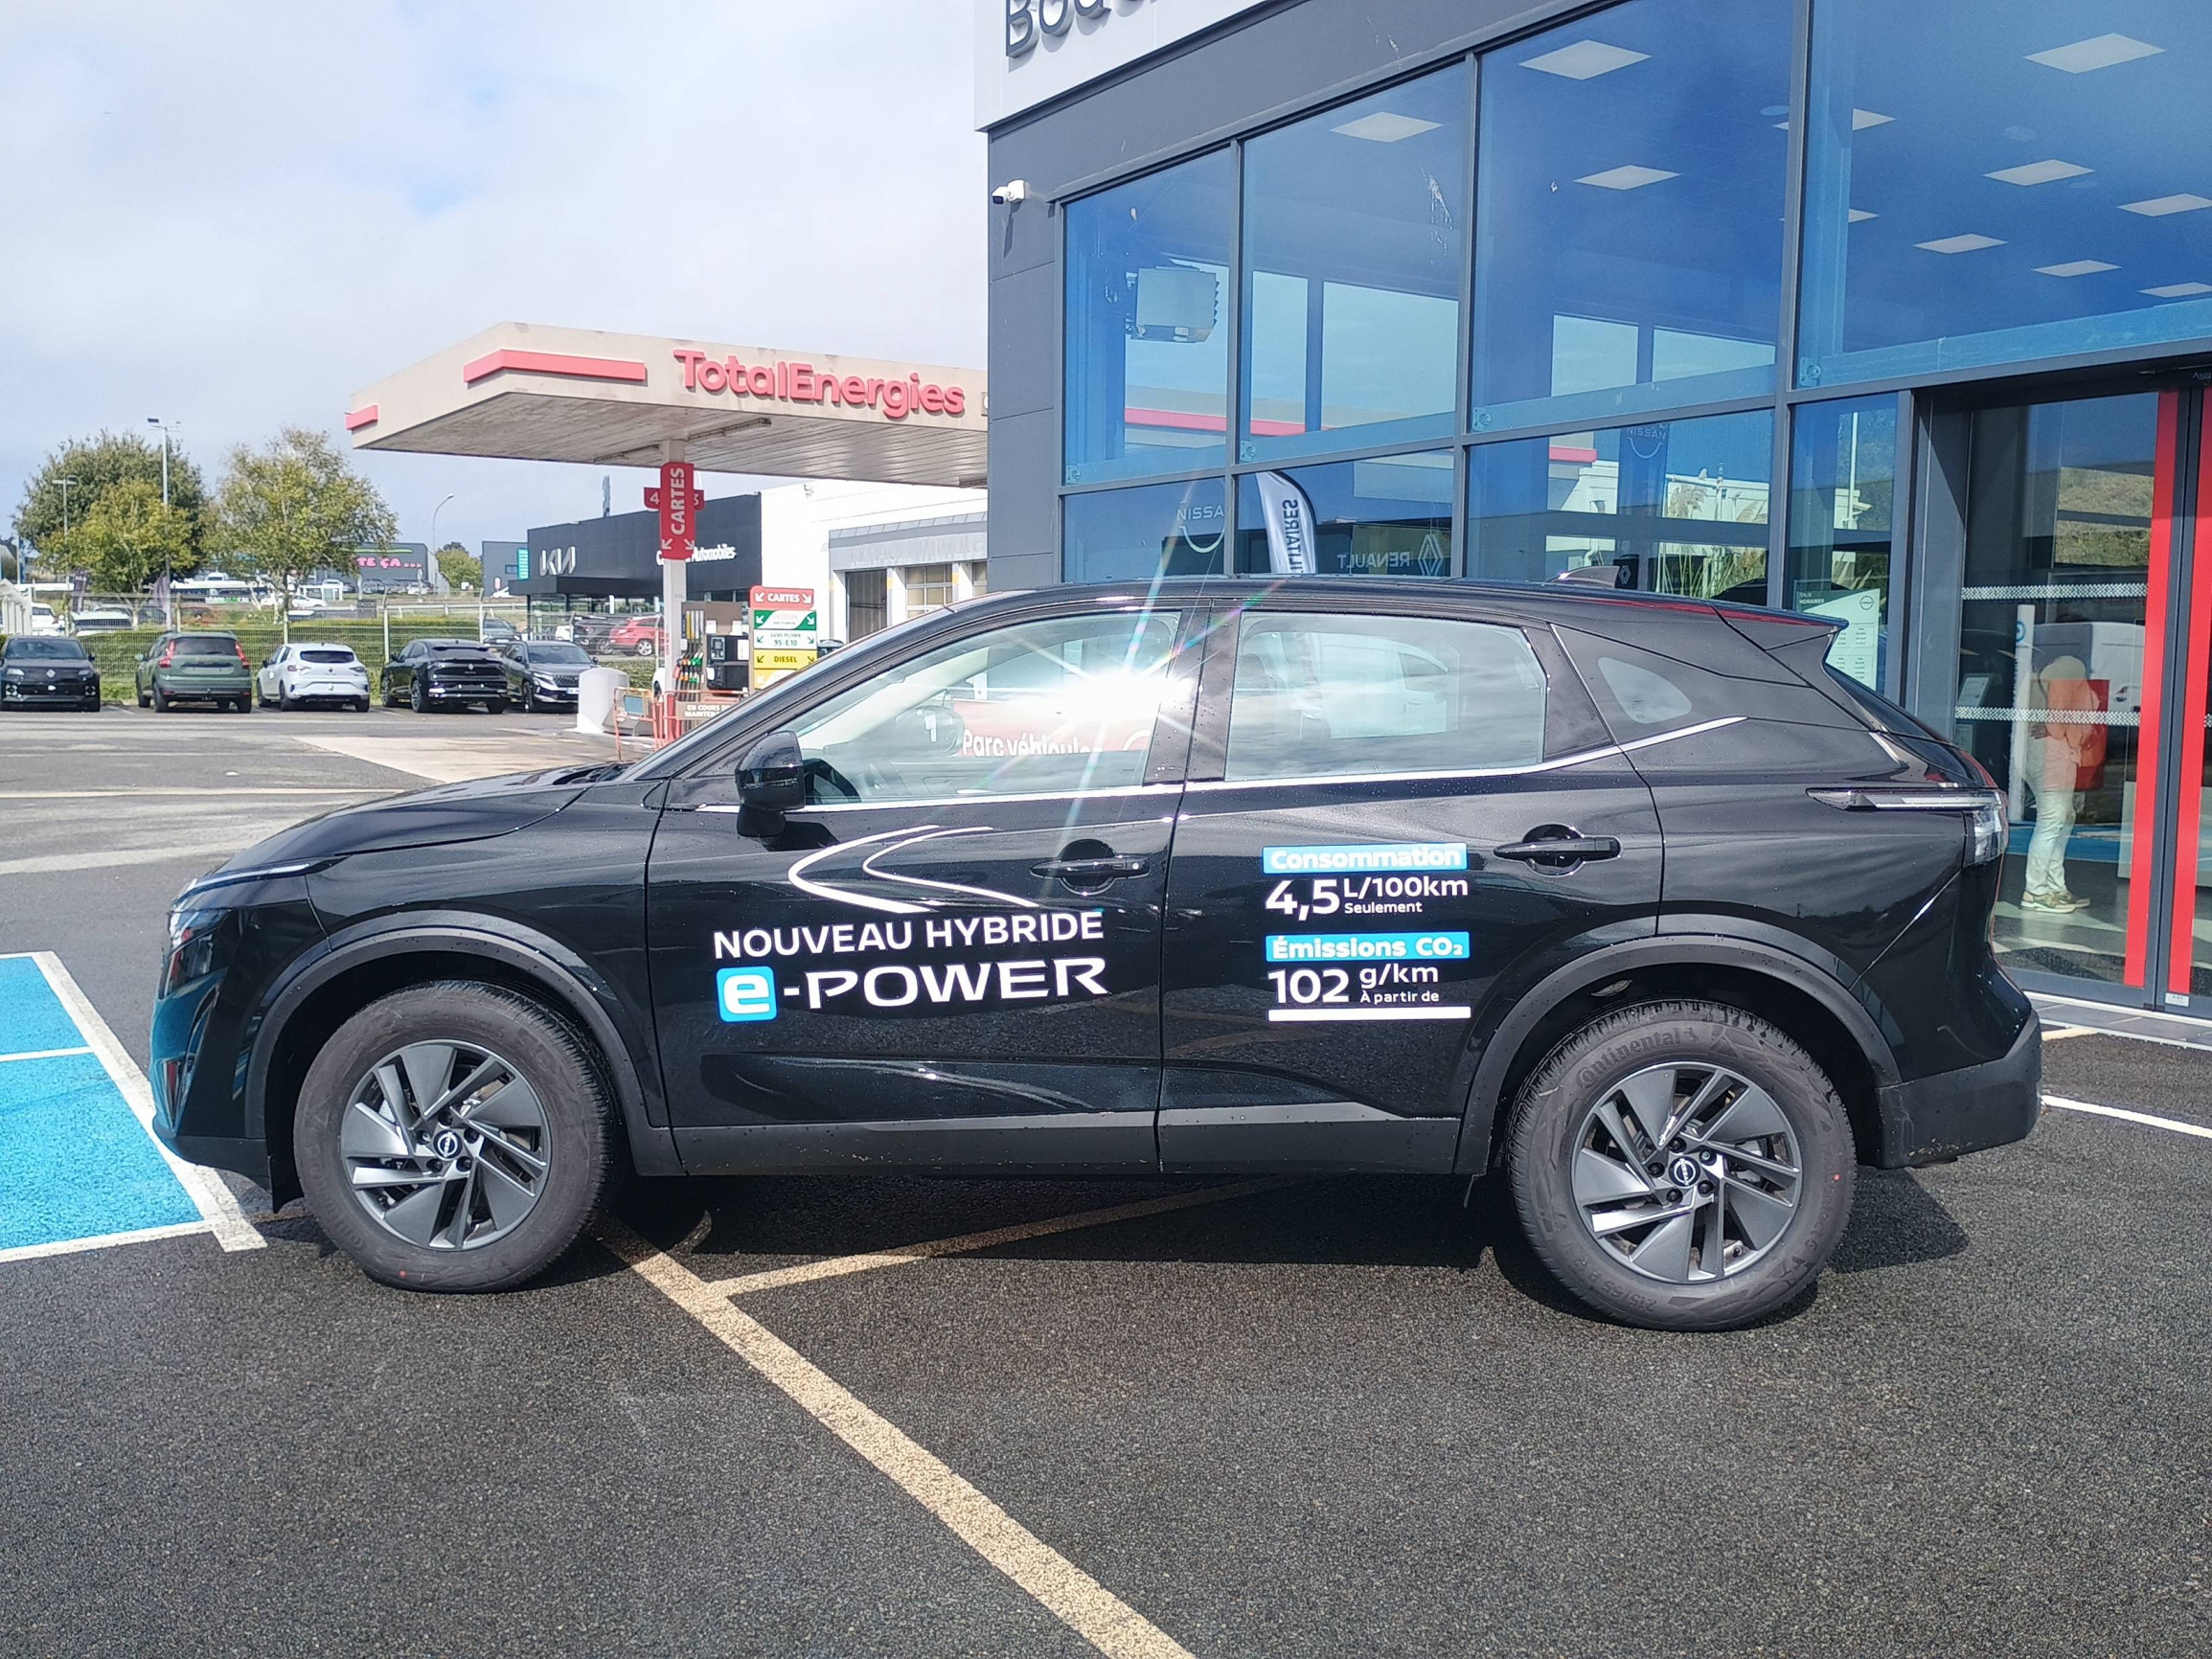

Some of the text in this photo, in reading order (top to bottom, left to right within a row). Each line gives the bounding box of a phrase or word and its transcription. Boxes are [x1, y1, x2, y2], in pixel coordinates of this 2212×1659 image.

[673, 350, 966, 419] TotalEnergies
[1626, 426, 1667, 440] NISSAN
[650, 491, 660, 505] 4
[670, 467, 686, 535] CARTES
[1176, 505, 1225, 521] NISSA
[767, 592, 800, 602] CARTES
[962, 729, 1005, 757] Parc
[1269, 846, 1461, 870] Consommation
[1265, 875, 1469, 920] 4,5 L/100km
[1344, 901, 1423, 915] Seulement
[714, 911, 1104, 959] NOUVEAU HYBRIDE
[1272, 936, 1407, 960] Émissions
[1267, 964, 1439, 1004] 102 g/km
[1374, 990, 1418, 1005] partir
[1421, 991, 1439, 1003] de
[1579, 1028, 1679, 1088] Continental
